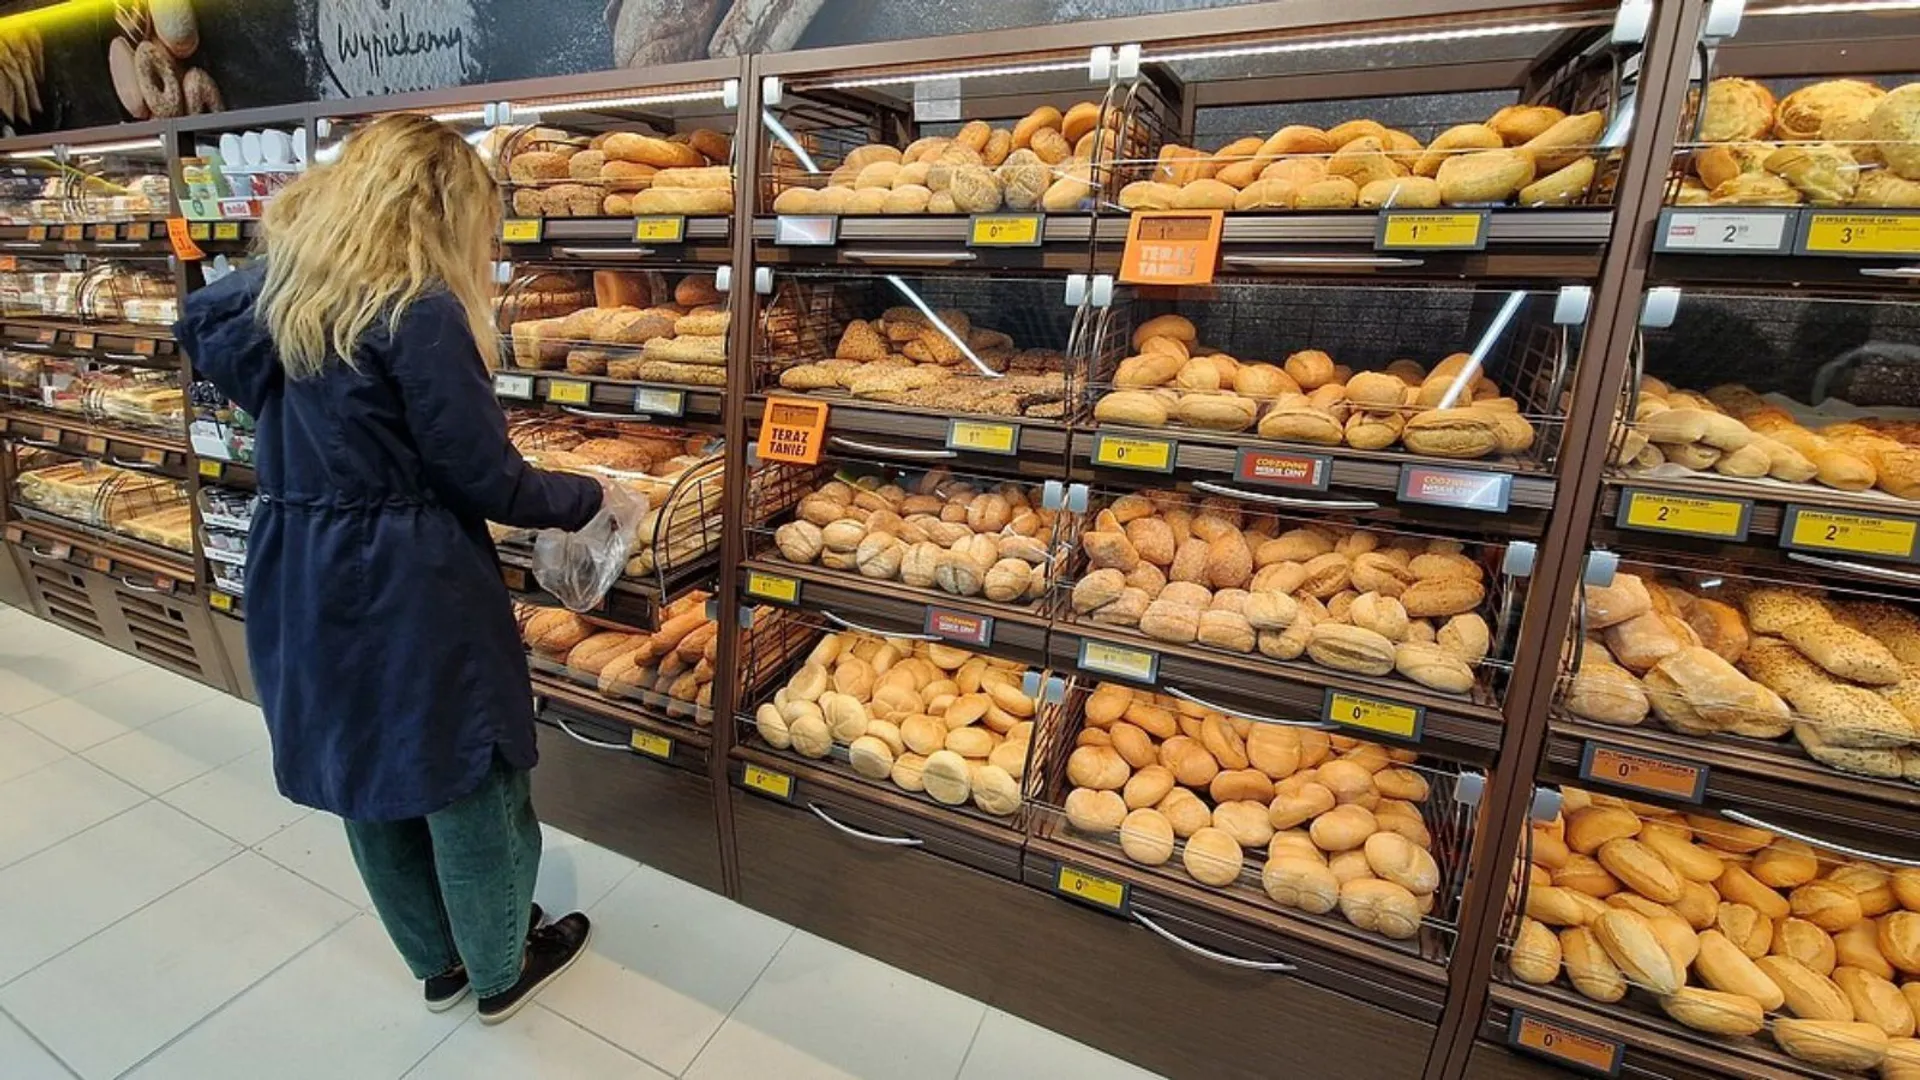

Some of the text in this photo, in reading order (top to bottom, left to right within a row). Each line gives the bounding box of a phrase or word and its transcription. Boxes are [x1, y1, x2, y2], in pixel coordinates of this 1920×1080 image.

[338, 12, 467, 77] Wypiekamy
[1722, 225, 1736, 243] 2
[1840, 227, 1852, 244] 3
[772, 428, 809, 442] TERAZ
[770, 442, 807, 456] TANIEJ
[1657, 506, 1669, 521] 2
[1825, 525, 1837, 540] 2
[1353, 706, 1361, 719] 0
[1619, 763, 1629, 776] 0
[1544, 1034, 1553, 1046] 0
